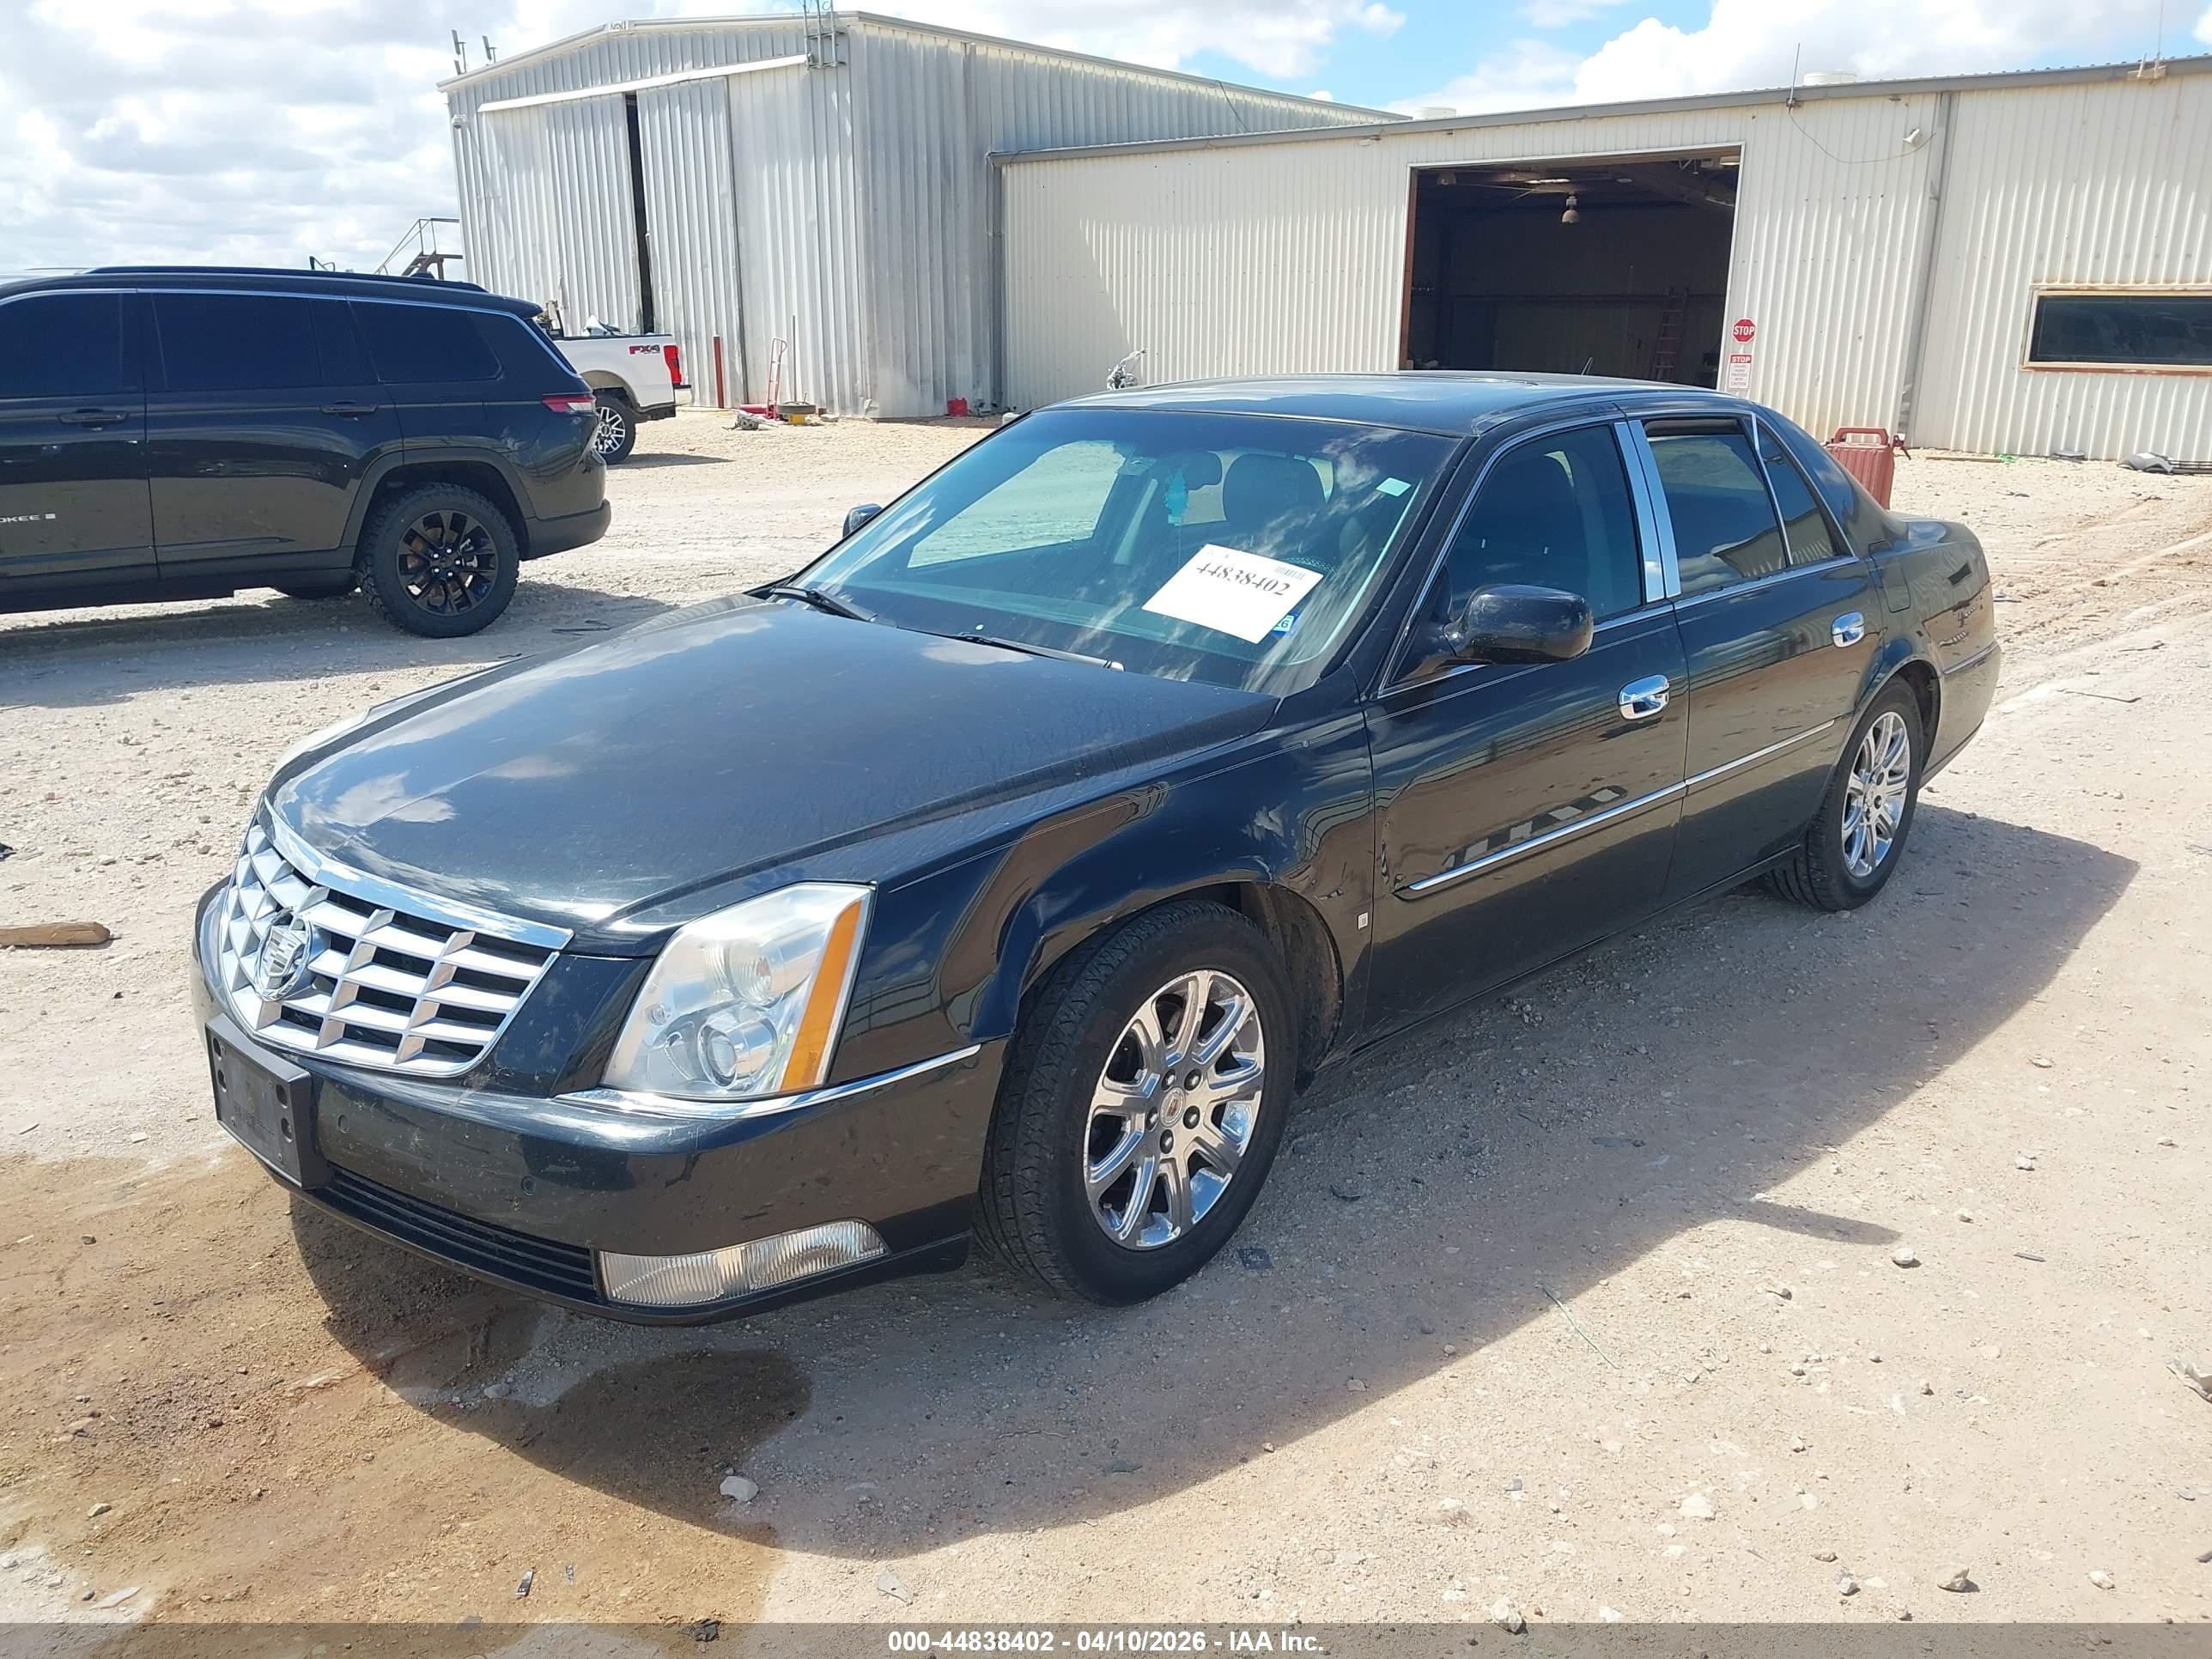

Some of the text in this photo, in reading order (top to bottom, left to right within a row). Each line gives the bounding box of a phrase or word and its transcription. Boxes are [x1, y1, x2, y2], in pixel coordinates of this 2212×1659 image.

[1734, 325, 1755, 336] STOP
[629, 344, 660, 355] FX4
[1196, 562, 1291, 596] 44838402
